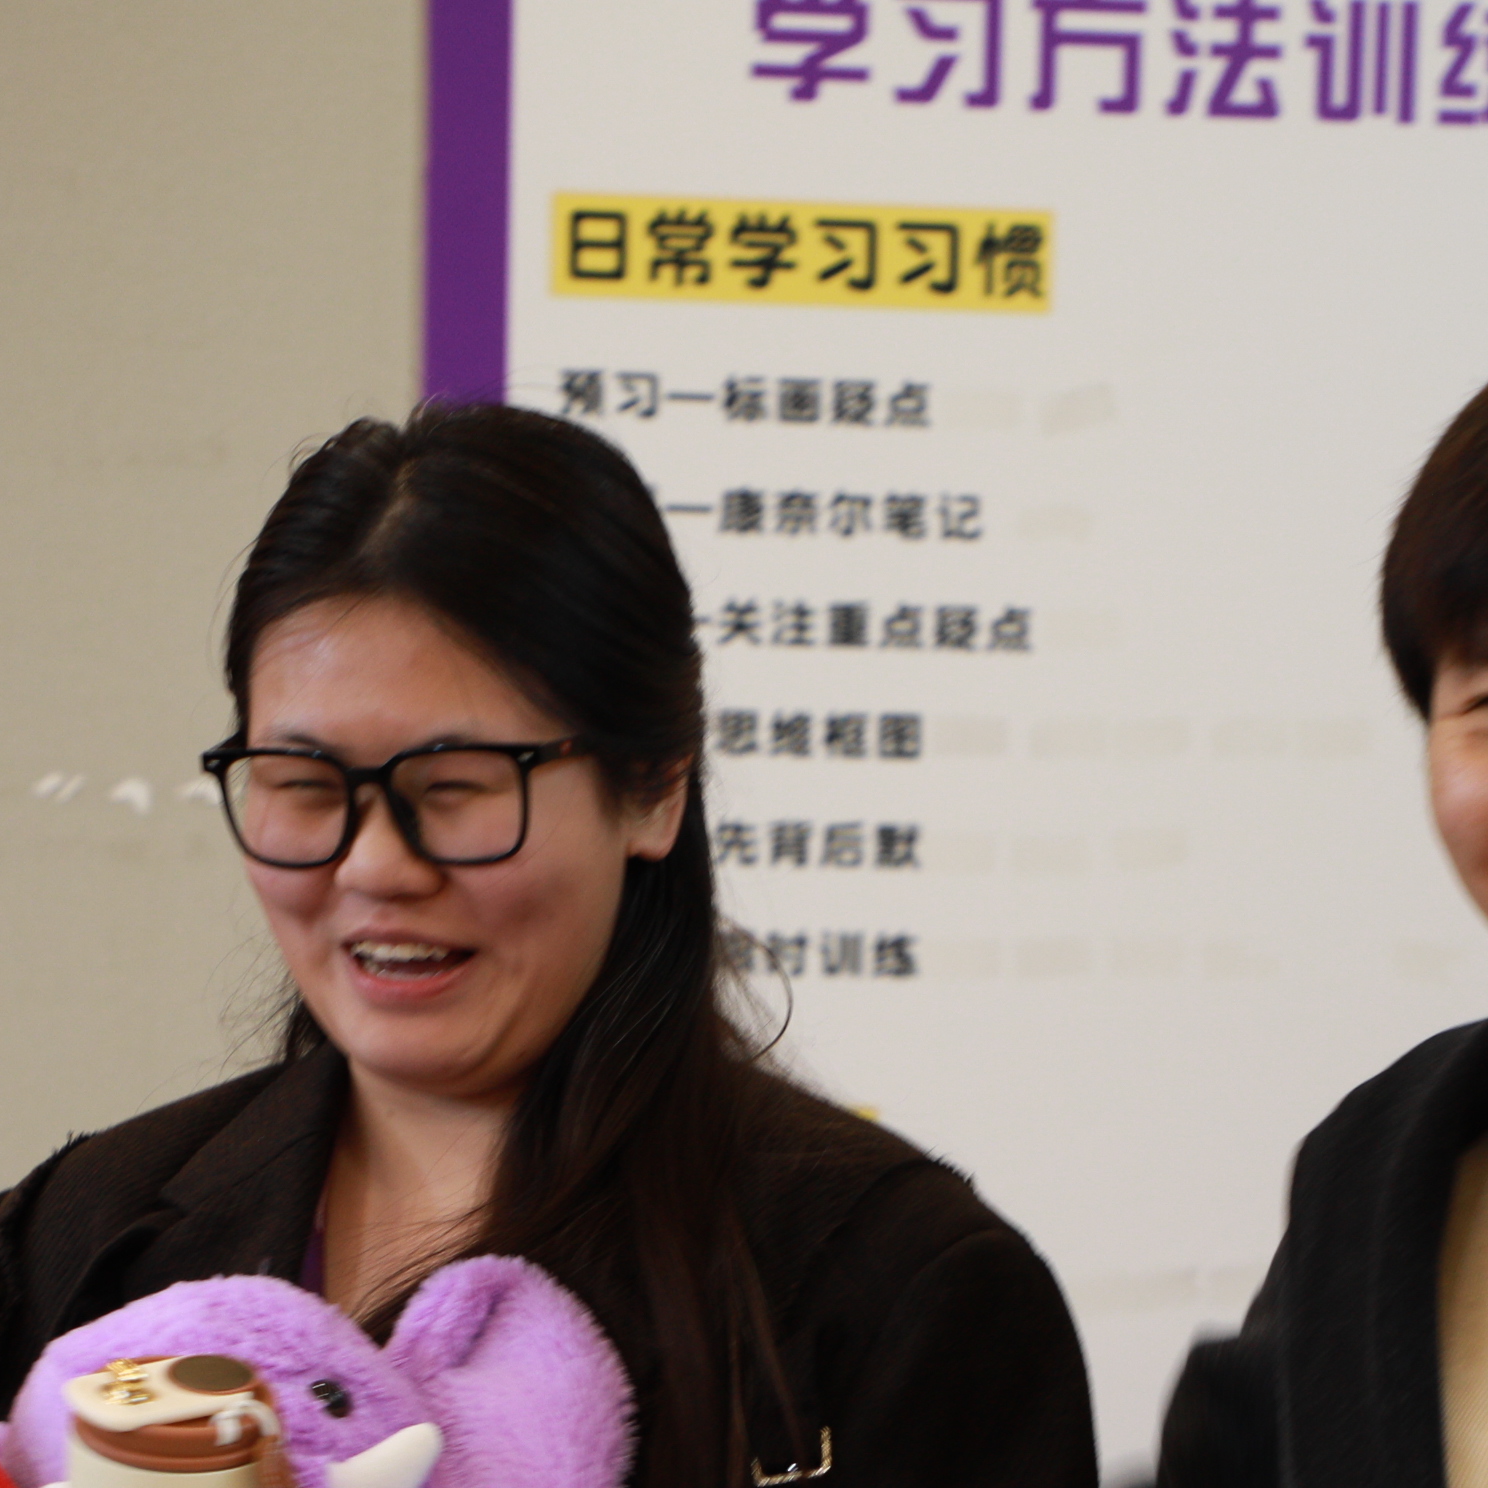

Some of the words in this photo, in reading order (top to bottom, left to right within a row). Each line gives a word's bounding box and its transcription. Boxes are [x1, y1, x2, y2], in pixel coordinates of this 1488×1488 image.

[568, 207, 1047, 299] 日常学习习惯
[717, 820, 922, 869] 先背后默
